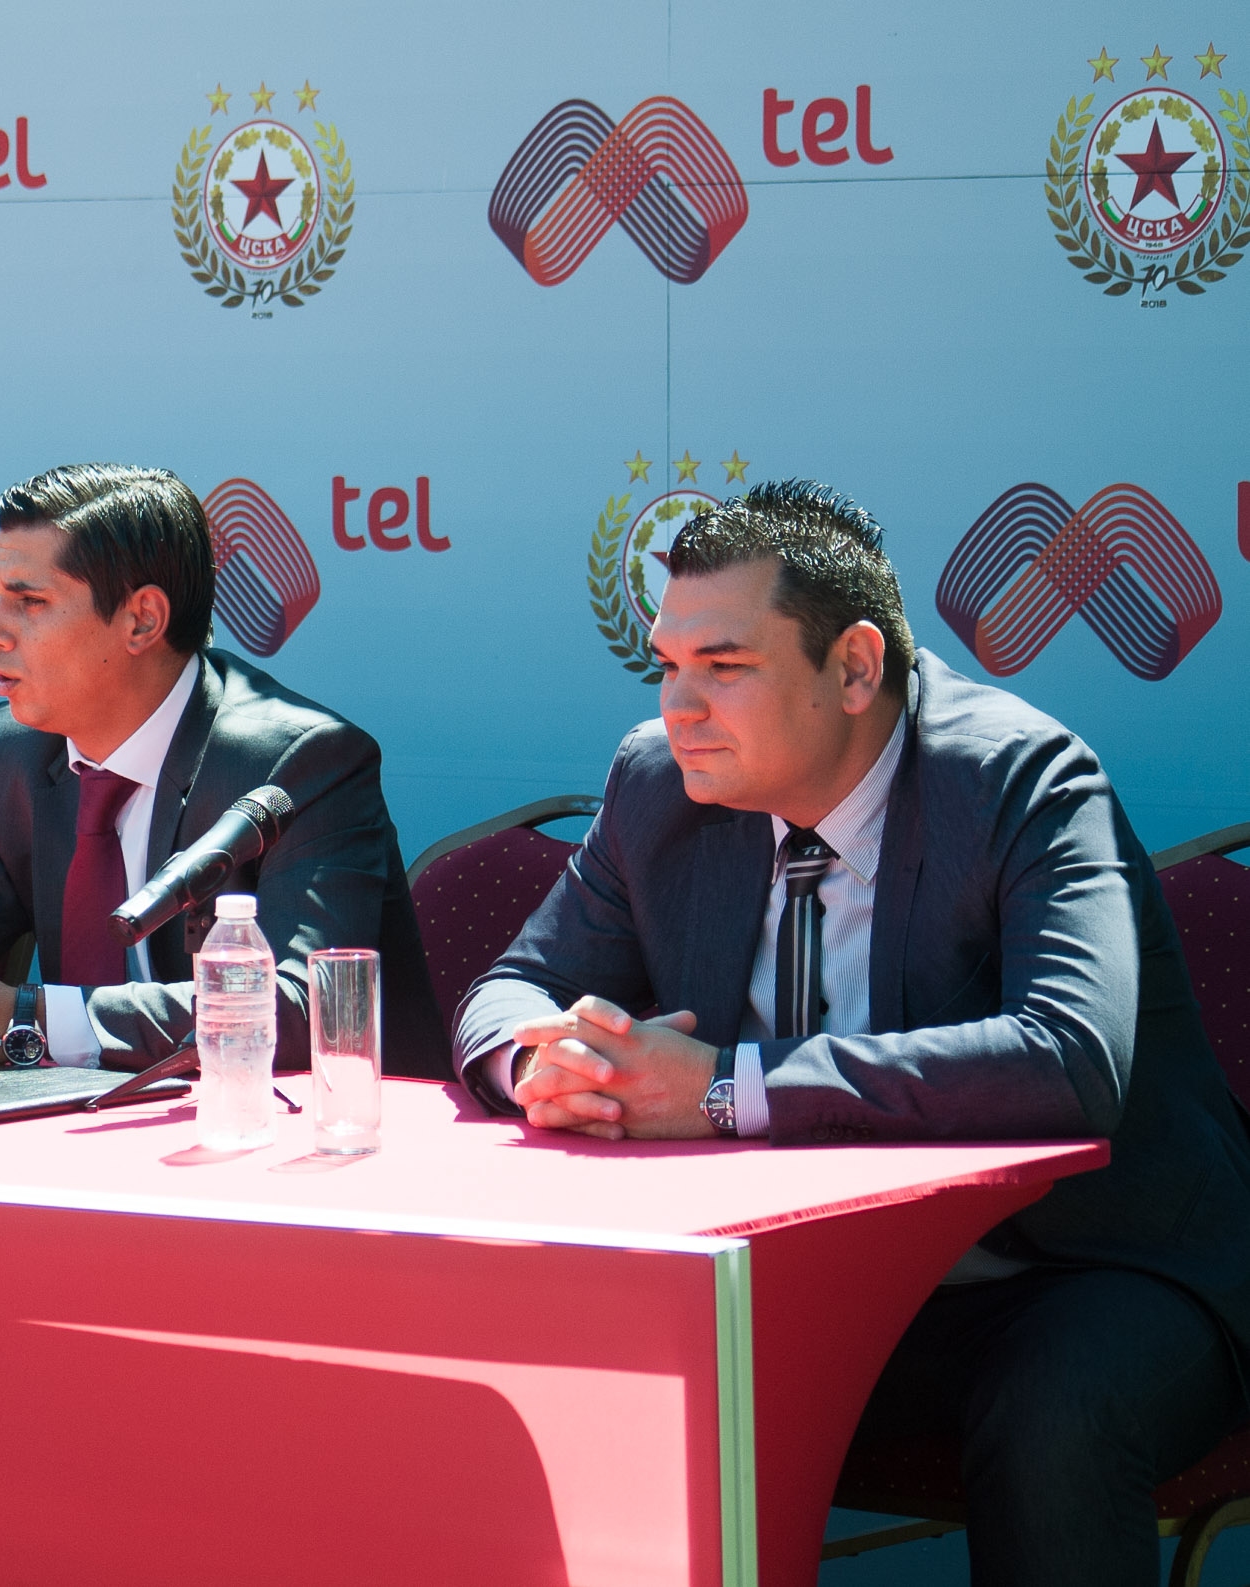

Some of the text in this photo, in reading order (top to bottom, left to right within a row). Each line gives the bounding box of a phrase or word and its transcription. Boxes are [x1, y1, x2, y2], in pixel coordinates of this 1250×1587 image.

[762, 84, 894, 167] tel
[1125, 217, 1184, 239] ЦСКА
[238, 238, 287, 257] ЦСКА
[1140, 300, 1167, 309] 2018
[332, 475, 452, 553] tel
